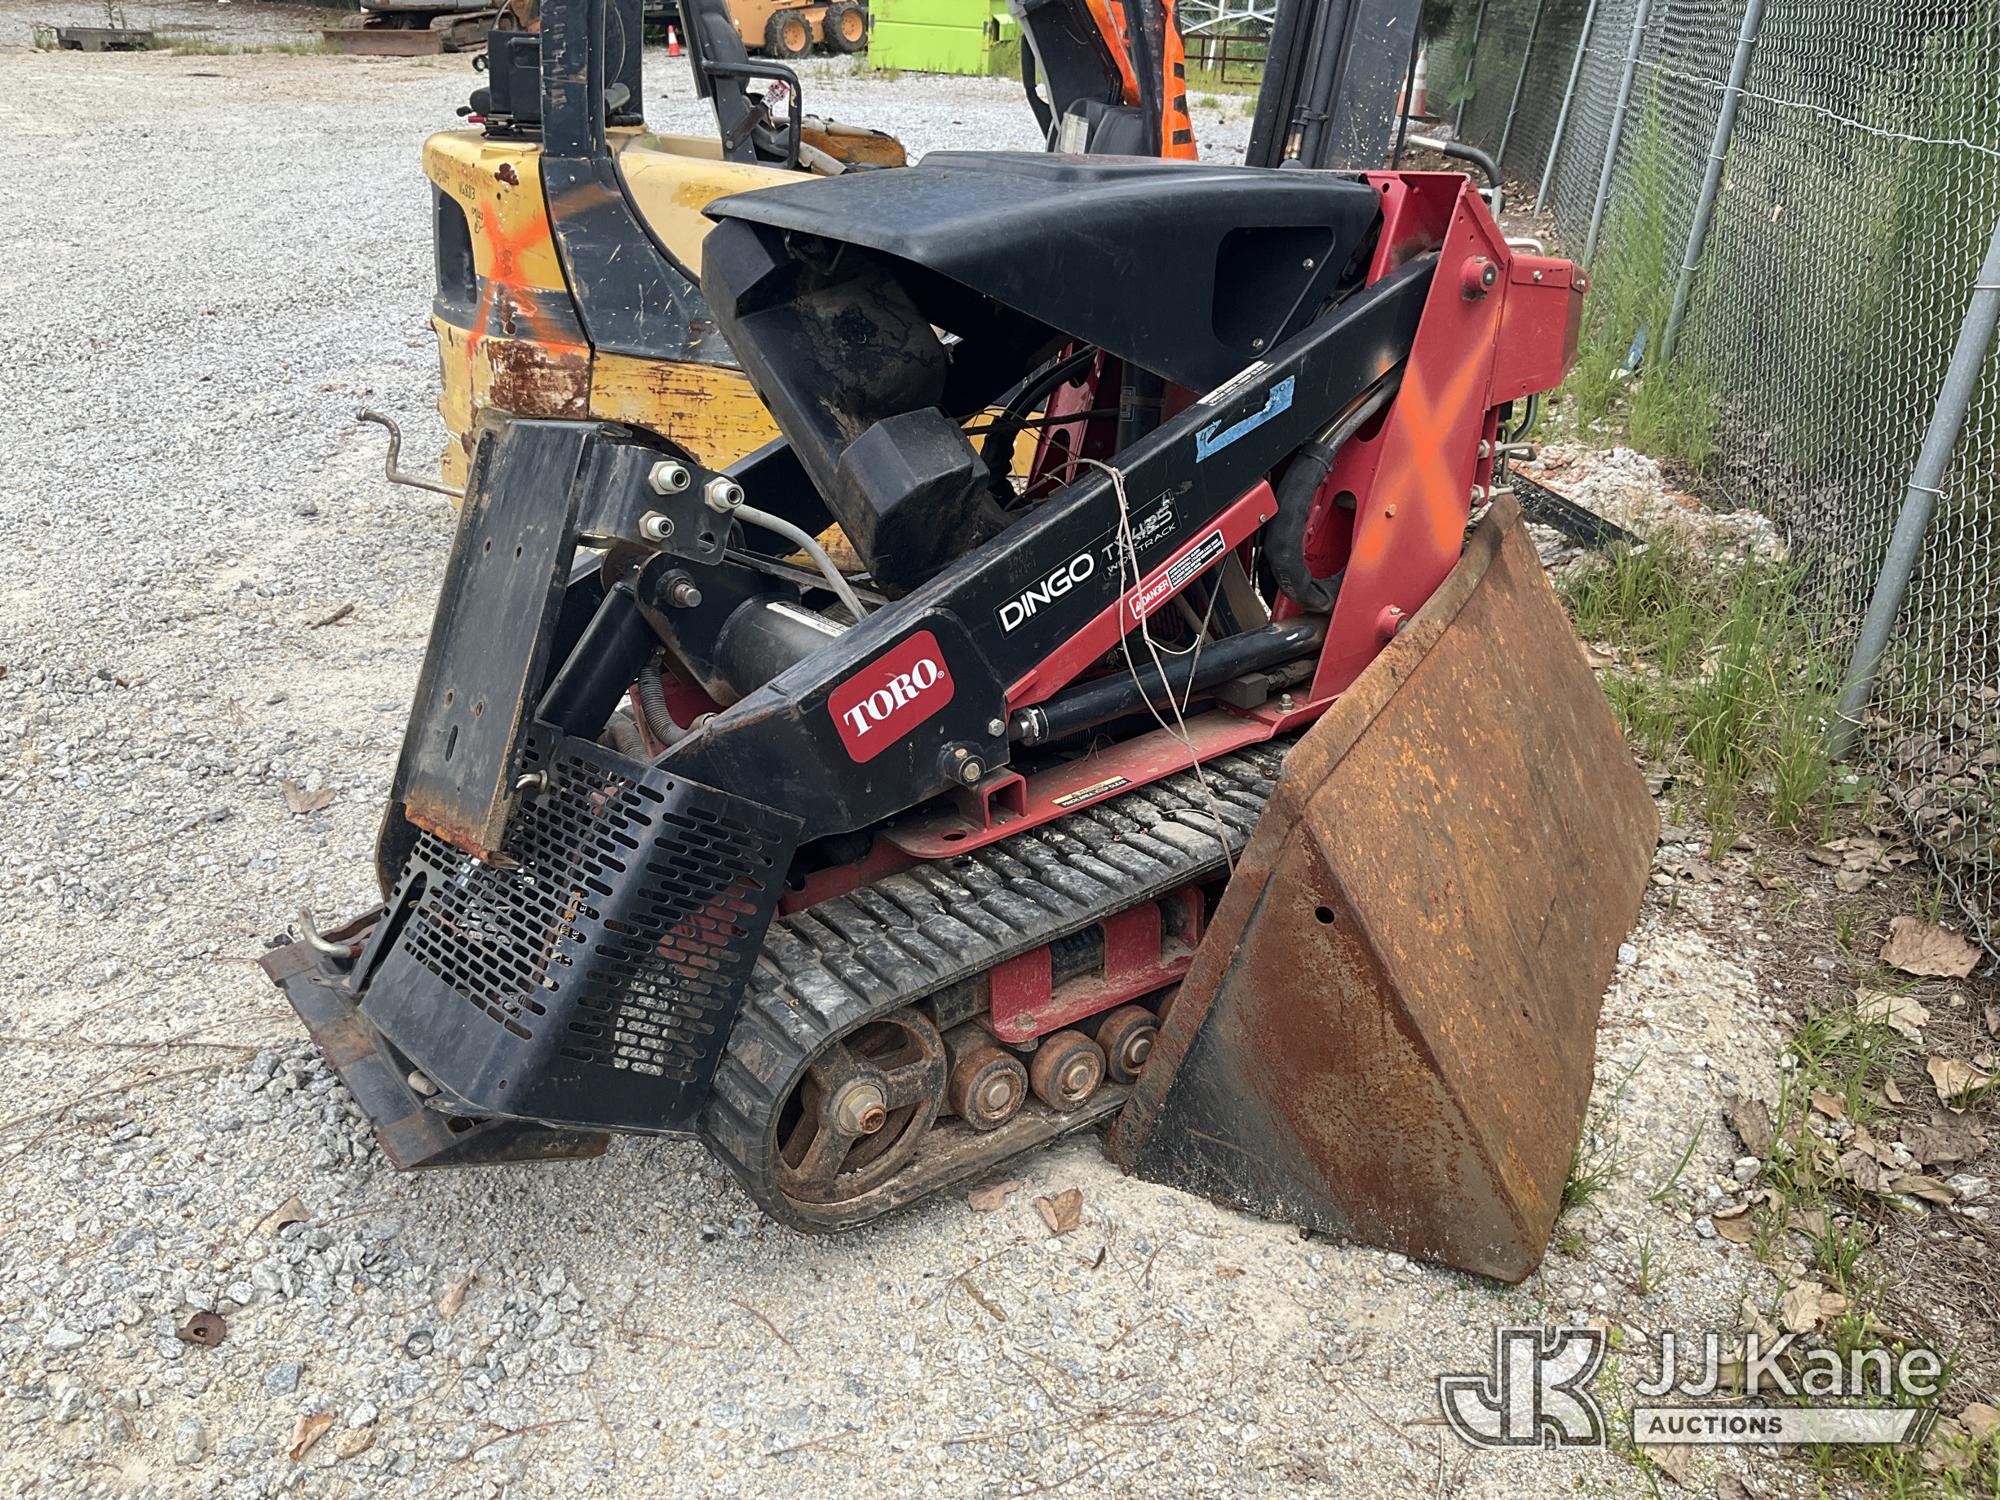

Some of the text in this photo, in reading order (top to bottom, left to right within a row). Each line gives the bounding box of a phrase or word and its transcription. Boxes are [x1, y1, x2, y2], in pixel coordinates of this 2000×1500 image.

[1137, 522, 1176, 551] TRACK
[1000, 553, 1094, 632] DINGO
[1142, 580, 1170, 609] DANGER
[843, 659, 937, 737] TORO
